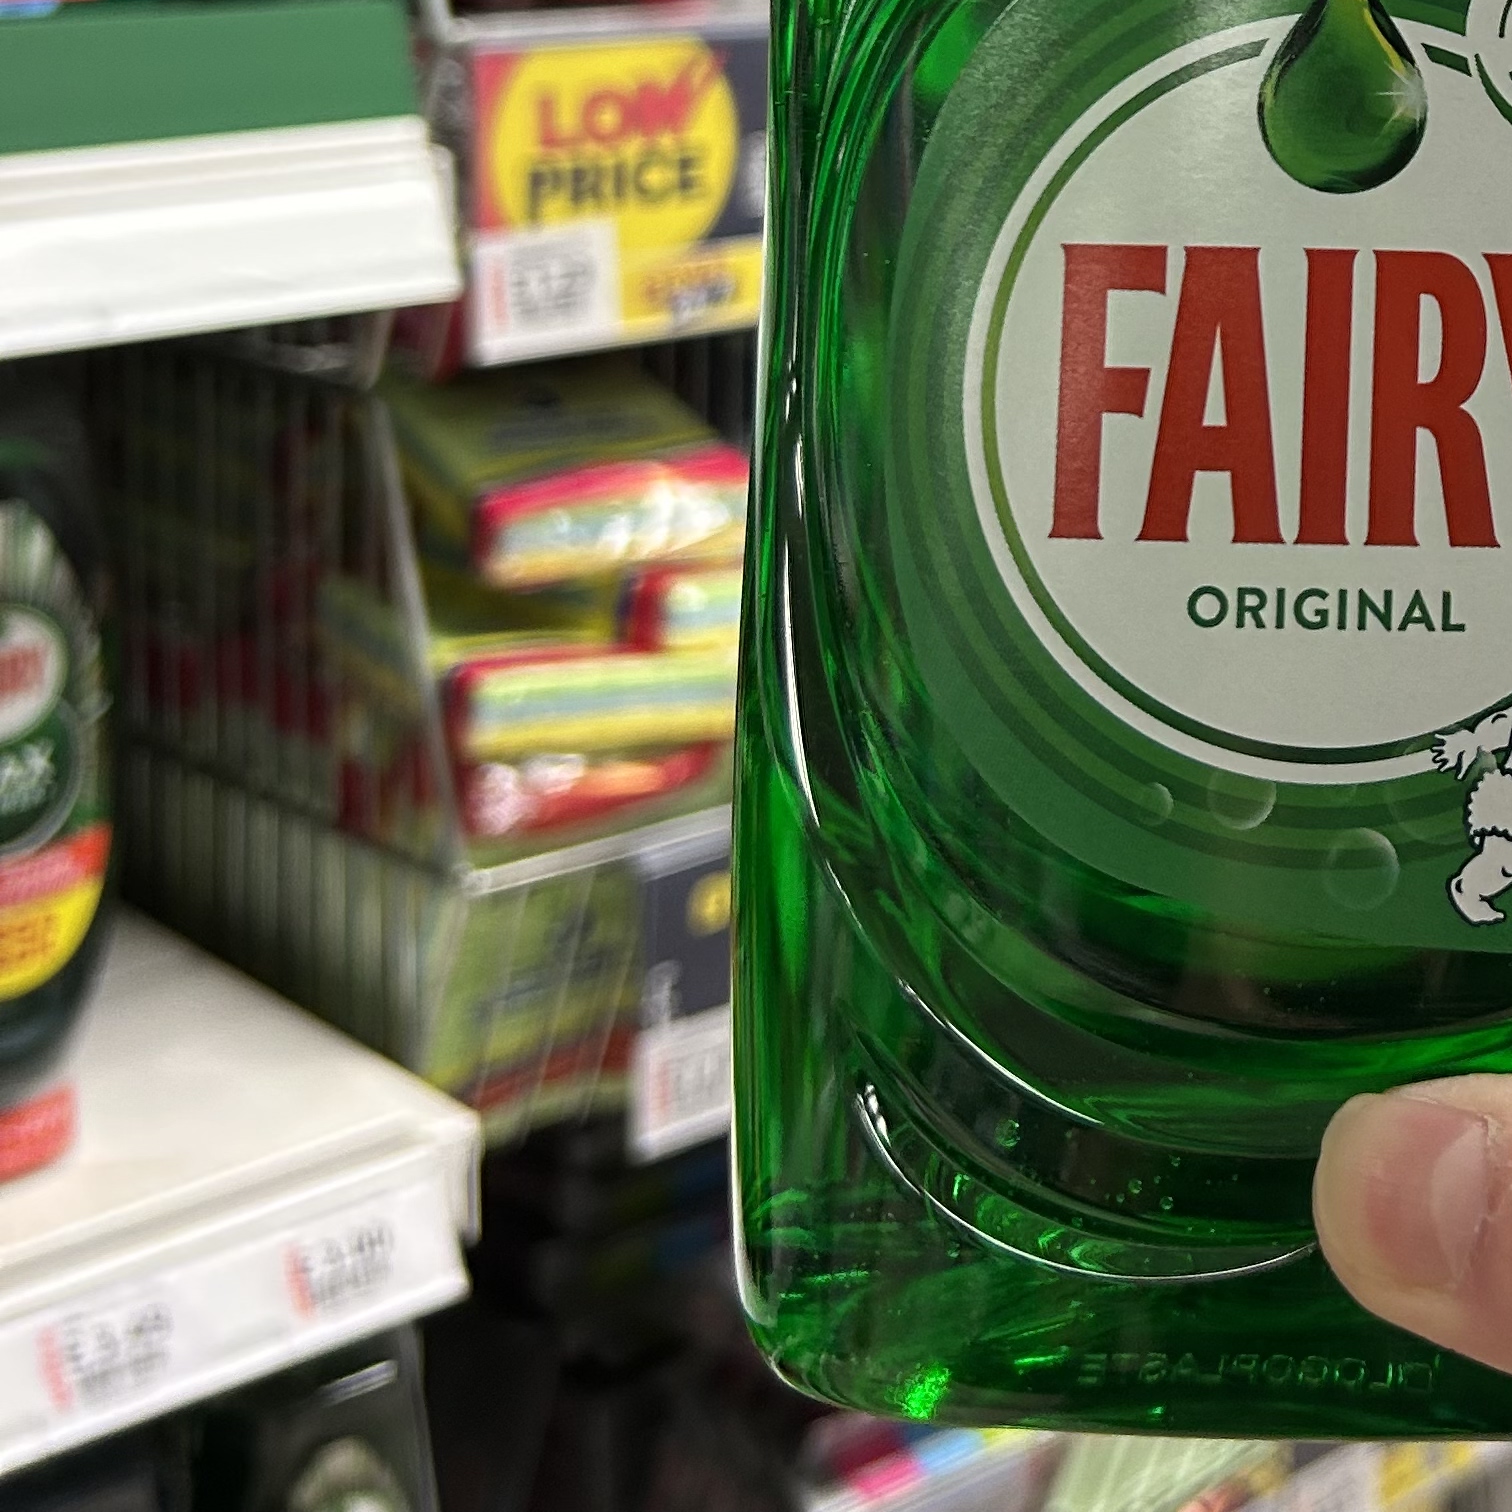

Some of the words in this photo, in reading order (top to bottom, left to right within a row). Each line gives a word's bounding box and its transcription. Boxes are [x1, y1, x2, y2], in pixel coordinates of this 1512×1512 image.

[536, 78, 694, 150] LOW
[526, 148, 710, 224] PRICE
[1186, 584, 1467, 633] ORIGINAL
